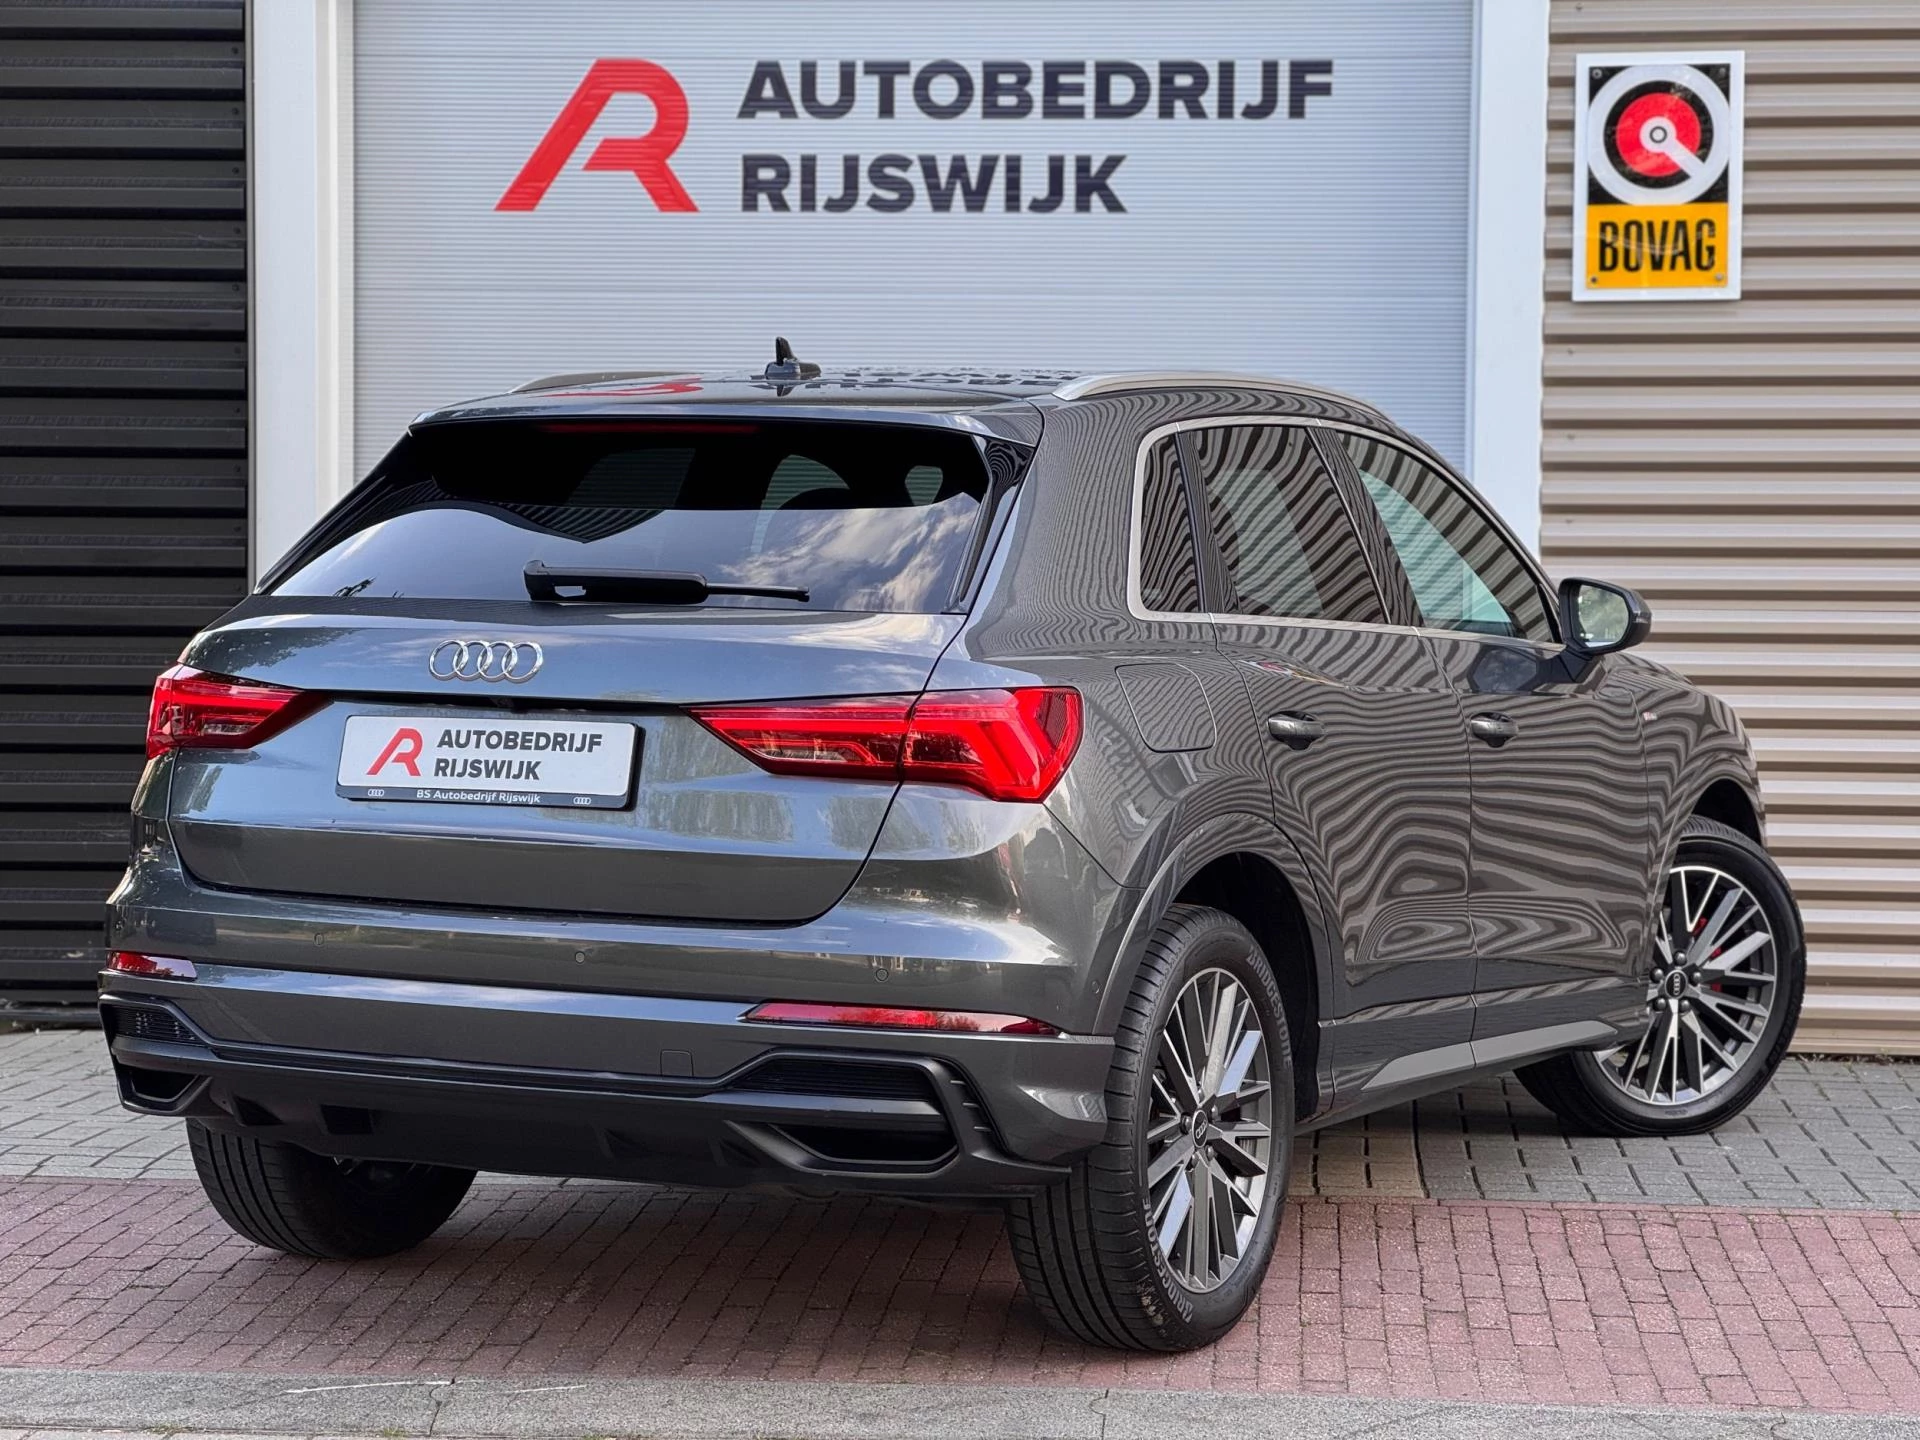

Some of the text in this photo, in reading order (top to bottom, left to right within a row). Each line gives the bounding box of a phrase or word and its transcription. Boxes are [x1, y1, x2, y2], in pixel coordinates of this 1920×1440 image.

[737, 59, 1333, 120] AUTOBEDRIJF
[741, 154, 1127, 214] RIJSWIJK
[1599, 218, 1717, 273] BOVAG
[433, 757, 542, 781] RIJSWIJK
[436, 729, 603, 753] AUTOBEDRIJF
[416, 789, 541, 804] BS Autobedrijf Rijswijk
[1246, 945, 1294, 1071] BRIDGESTONE
[1142, 1197, 1194, 1323] BRIDGESTONE
